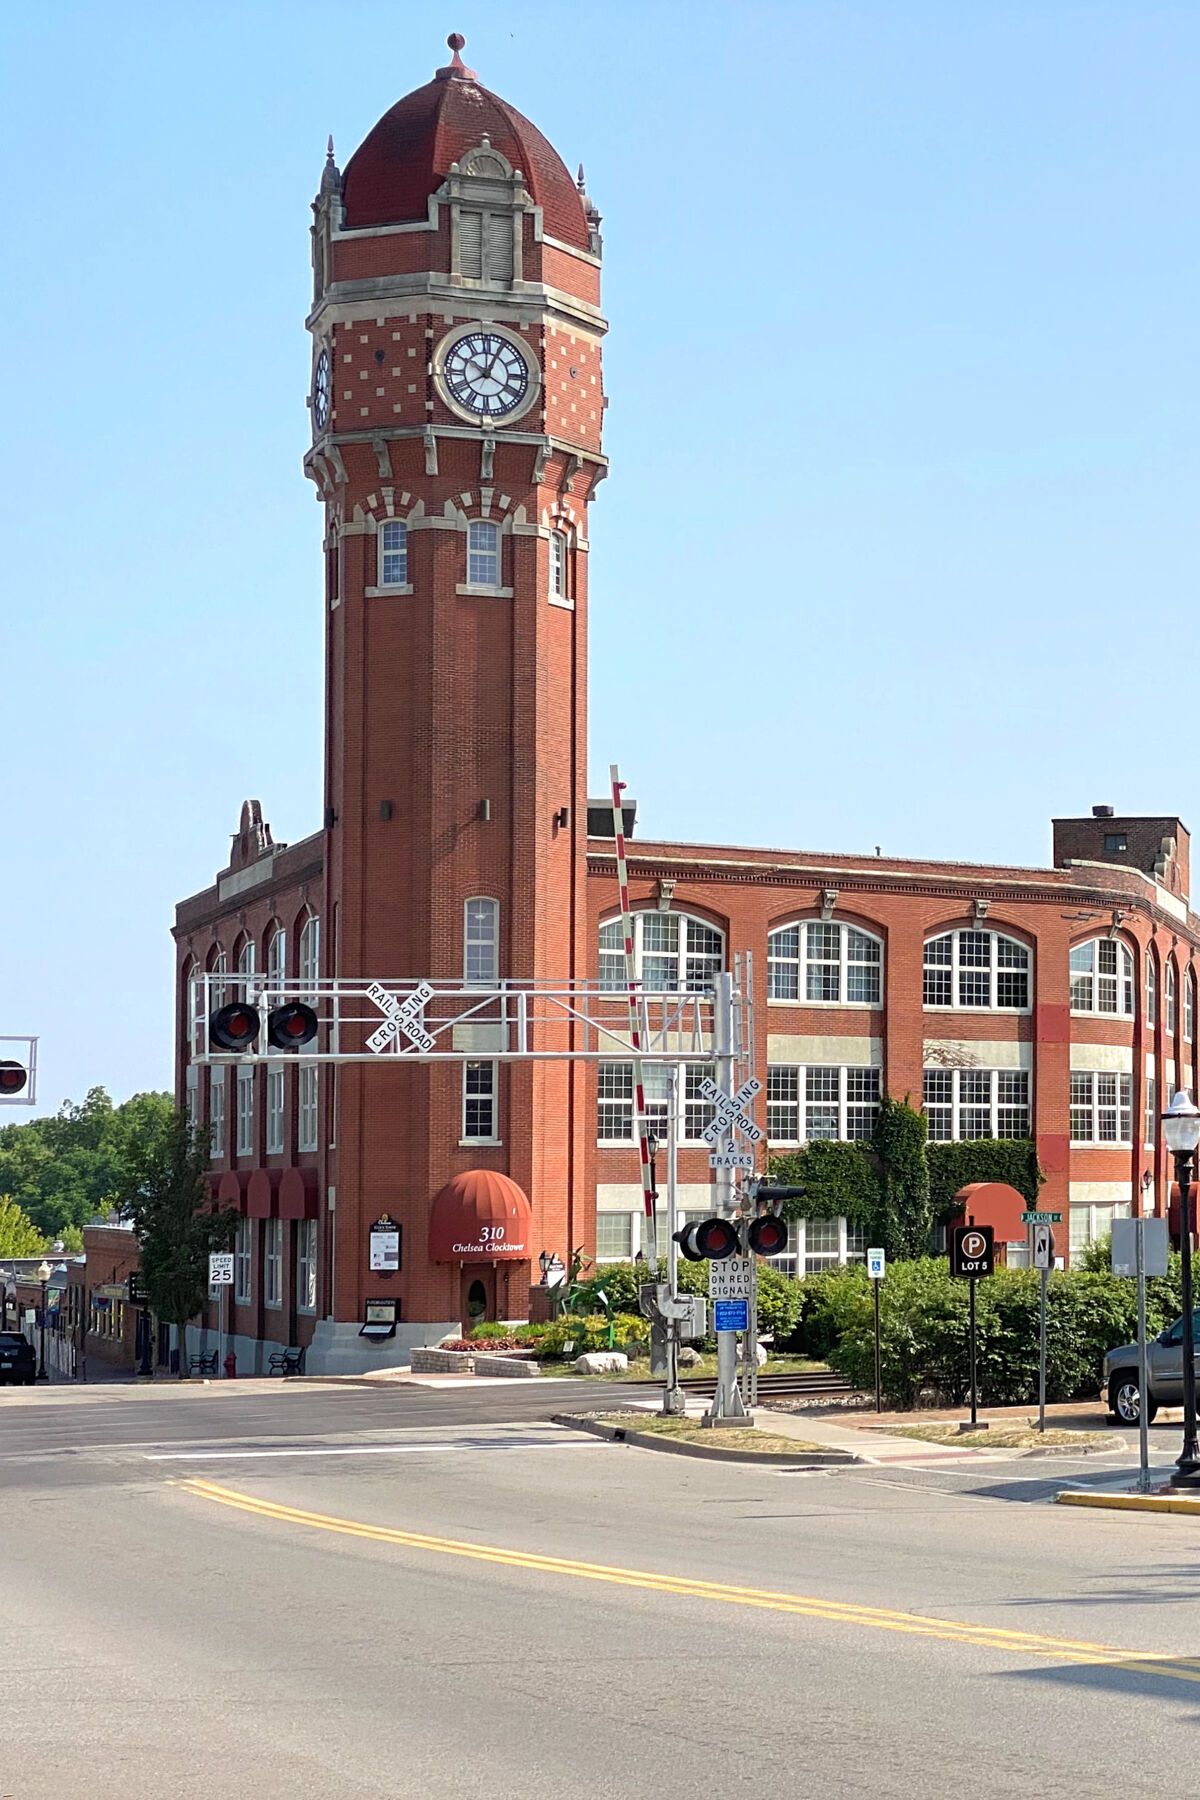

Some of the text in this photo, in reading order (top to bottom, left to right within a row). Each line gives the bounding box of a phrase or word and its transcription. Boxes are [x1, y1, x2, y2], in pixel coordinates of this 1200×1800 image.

[369, 985, 432, 1049] RAIL ROAD
[372, 988, 430, 1047] CROSSING
[701, 1081, 760, 1140] RAIL ROAD
[704, 1080, 759, 1142] CROSSING
[727, 1142, 735, 1153] 2
[710, 1157, 752, 1165] TRACKS
[479, 1226, 504, 1242] 310
[452, 1243, 524, 1252] Chelsea Clocktower
[968, 1237, 980, 1254] P
[711, 1261, 749, 1272] STOP
[961, 1262, 988, 1271] LOT 5
[211, 1270, 231, 1281] 25
[711, 1275, 749, 1283] ON RED
[711, 1286, 749, 1295] SIGNAL
